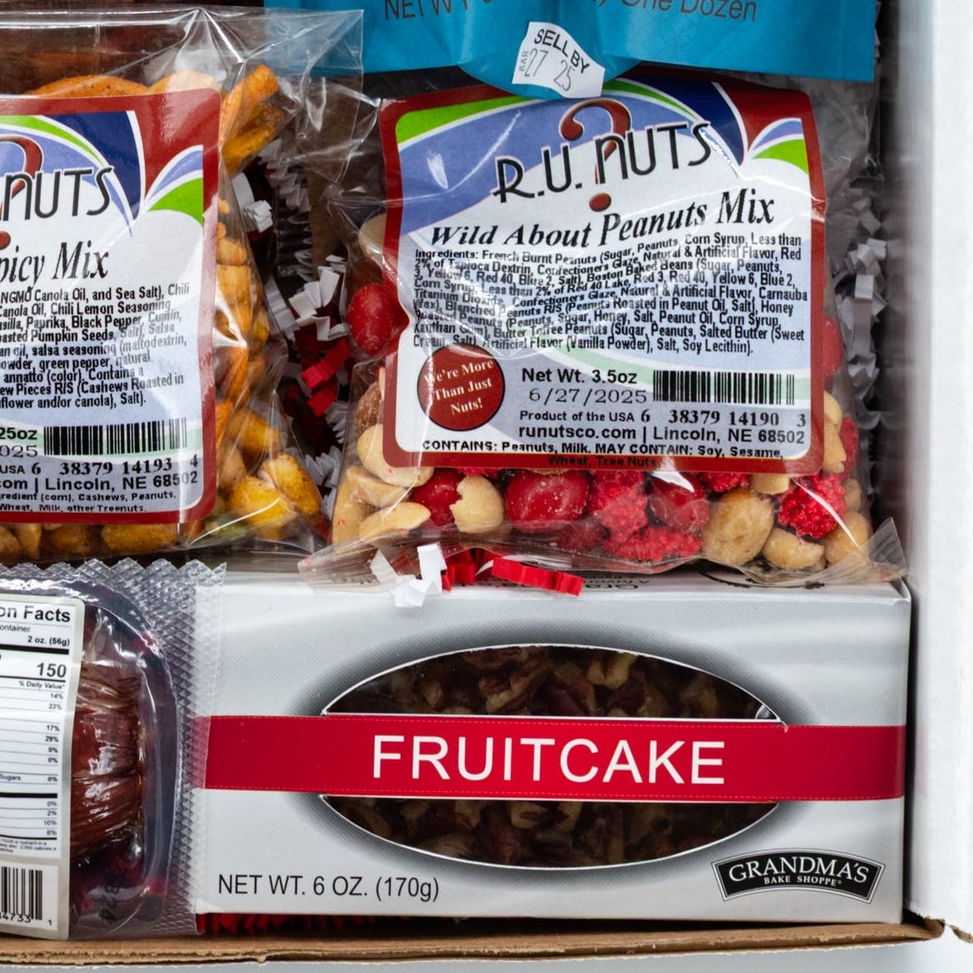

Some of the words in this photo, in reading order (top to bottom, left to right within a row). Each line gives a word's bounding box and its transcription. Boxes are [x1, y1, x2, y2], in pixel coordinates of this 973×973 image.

[534, 29, 568, 57] SELL
[570, 50, 589, 74] BY
[491, 146, 582, 203] R.U.
[430, 226, 498, 247] Wild
[506, 224, 592, 247] About
[598, 201, 707, 247] Peanuts
[718, 188, 774, 224] Mix
[54, 241, 109, 279] Mix
[461, 359, 493, 375] More
[522, 369, 552, 382] Net
[557, 369, 584, 383] Wt.
[592, 370, 637, 384] 3.5oz
[434, 385, 465, 401] Than
[467, 377, 493, 390] Just
[529, 388, 647, 406] 6/27/2025
[450, 398, 483, 415] Nuts!
[520, 411, 567, 421] Product
[572, 410, 583, 421] of
[586, 411, 605, 422] the
[609, 412, 634, 422] USA
[519, 426, 636, 439] runutsco.com
[654, 428, 720, 444] Lincoln,
[728, 429, 752, 442] NE
[758, 431, 804, 444] 68502
[0, 465, 25, 474] USA
[45, 478, 115, 492] Lincoln,
[123, 477, 147, 489] NE
[153, 471, 198, 488] 68502
[24, 605, 71, 623] Facts
[37, 662, 67, 678] 150
[372, 735, 726, 785] FRUITCAKE
[729, 857, 869, 883] GRANDMA'S
[764, 876, 791, 884] BAKE
[217, 875, 262, 896] NET
[268, 875, 307, 896] WT.
[313, 876, 325, 896] 6
[331, 876, 368, 896] OZ.
[375, 876, 439, 904] (170g)
